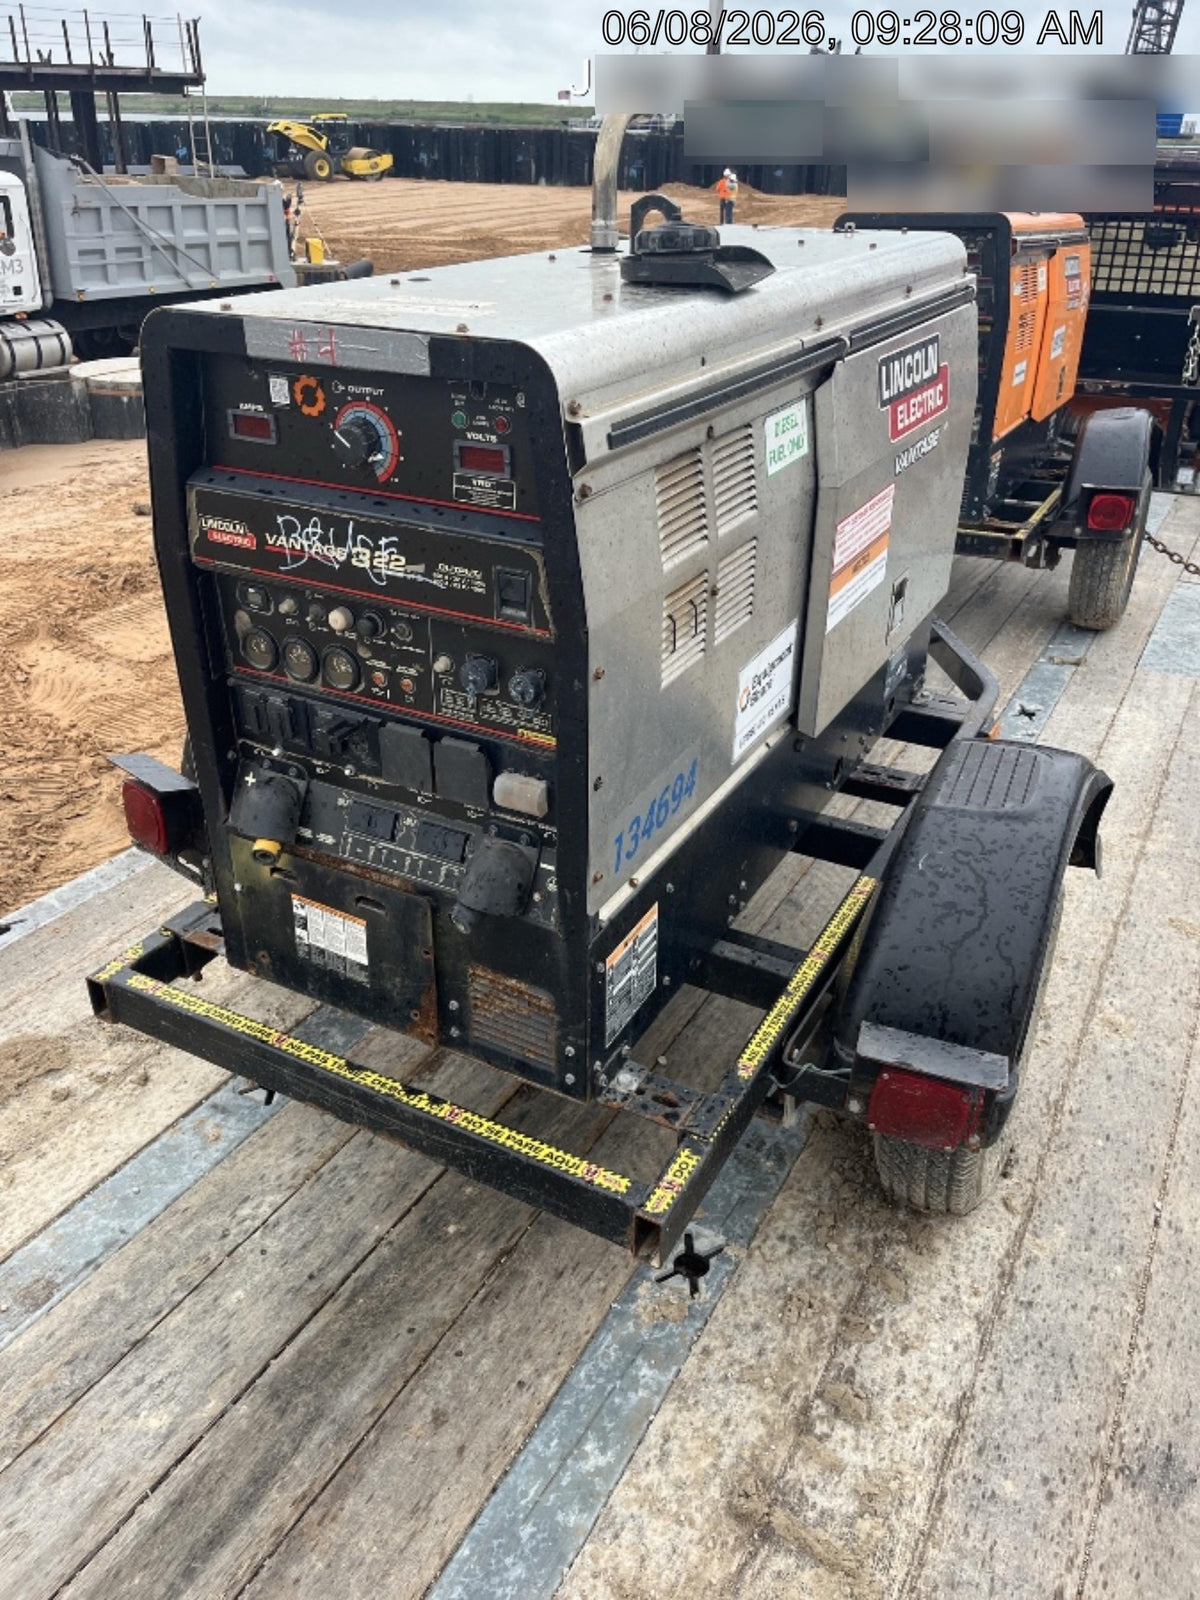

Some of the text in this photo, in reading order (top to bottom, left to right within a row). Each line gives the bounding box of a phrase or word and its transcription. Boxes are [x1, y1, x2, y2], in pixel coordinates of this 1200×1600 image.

[347, 384, 384, 396] OUTPUT
[881, 342, 938, 400] LINCOLN
[774, 412, 799, 438] DIESEL
[897, 383, 943, 431] ELECTRIC
[466, 431, 499, 444] VOLTS
[264, 532, 406, 573] VANTAGE 322
[614, 757, 698, 874] 134694
[461, 1115, 483, 1129] NO
[505, 1133, 545, 1154] PARE
[545, 1150, 581, 1170] AQUI
